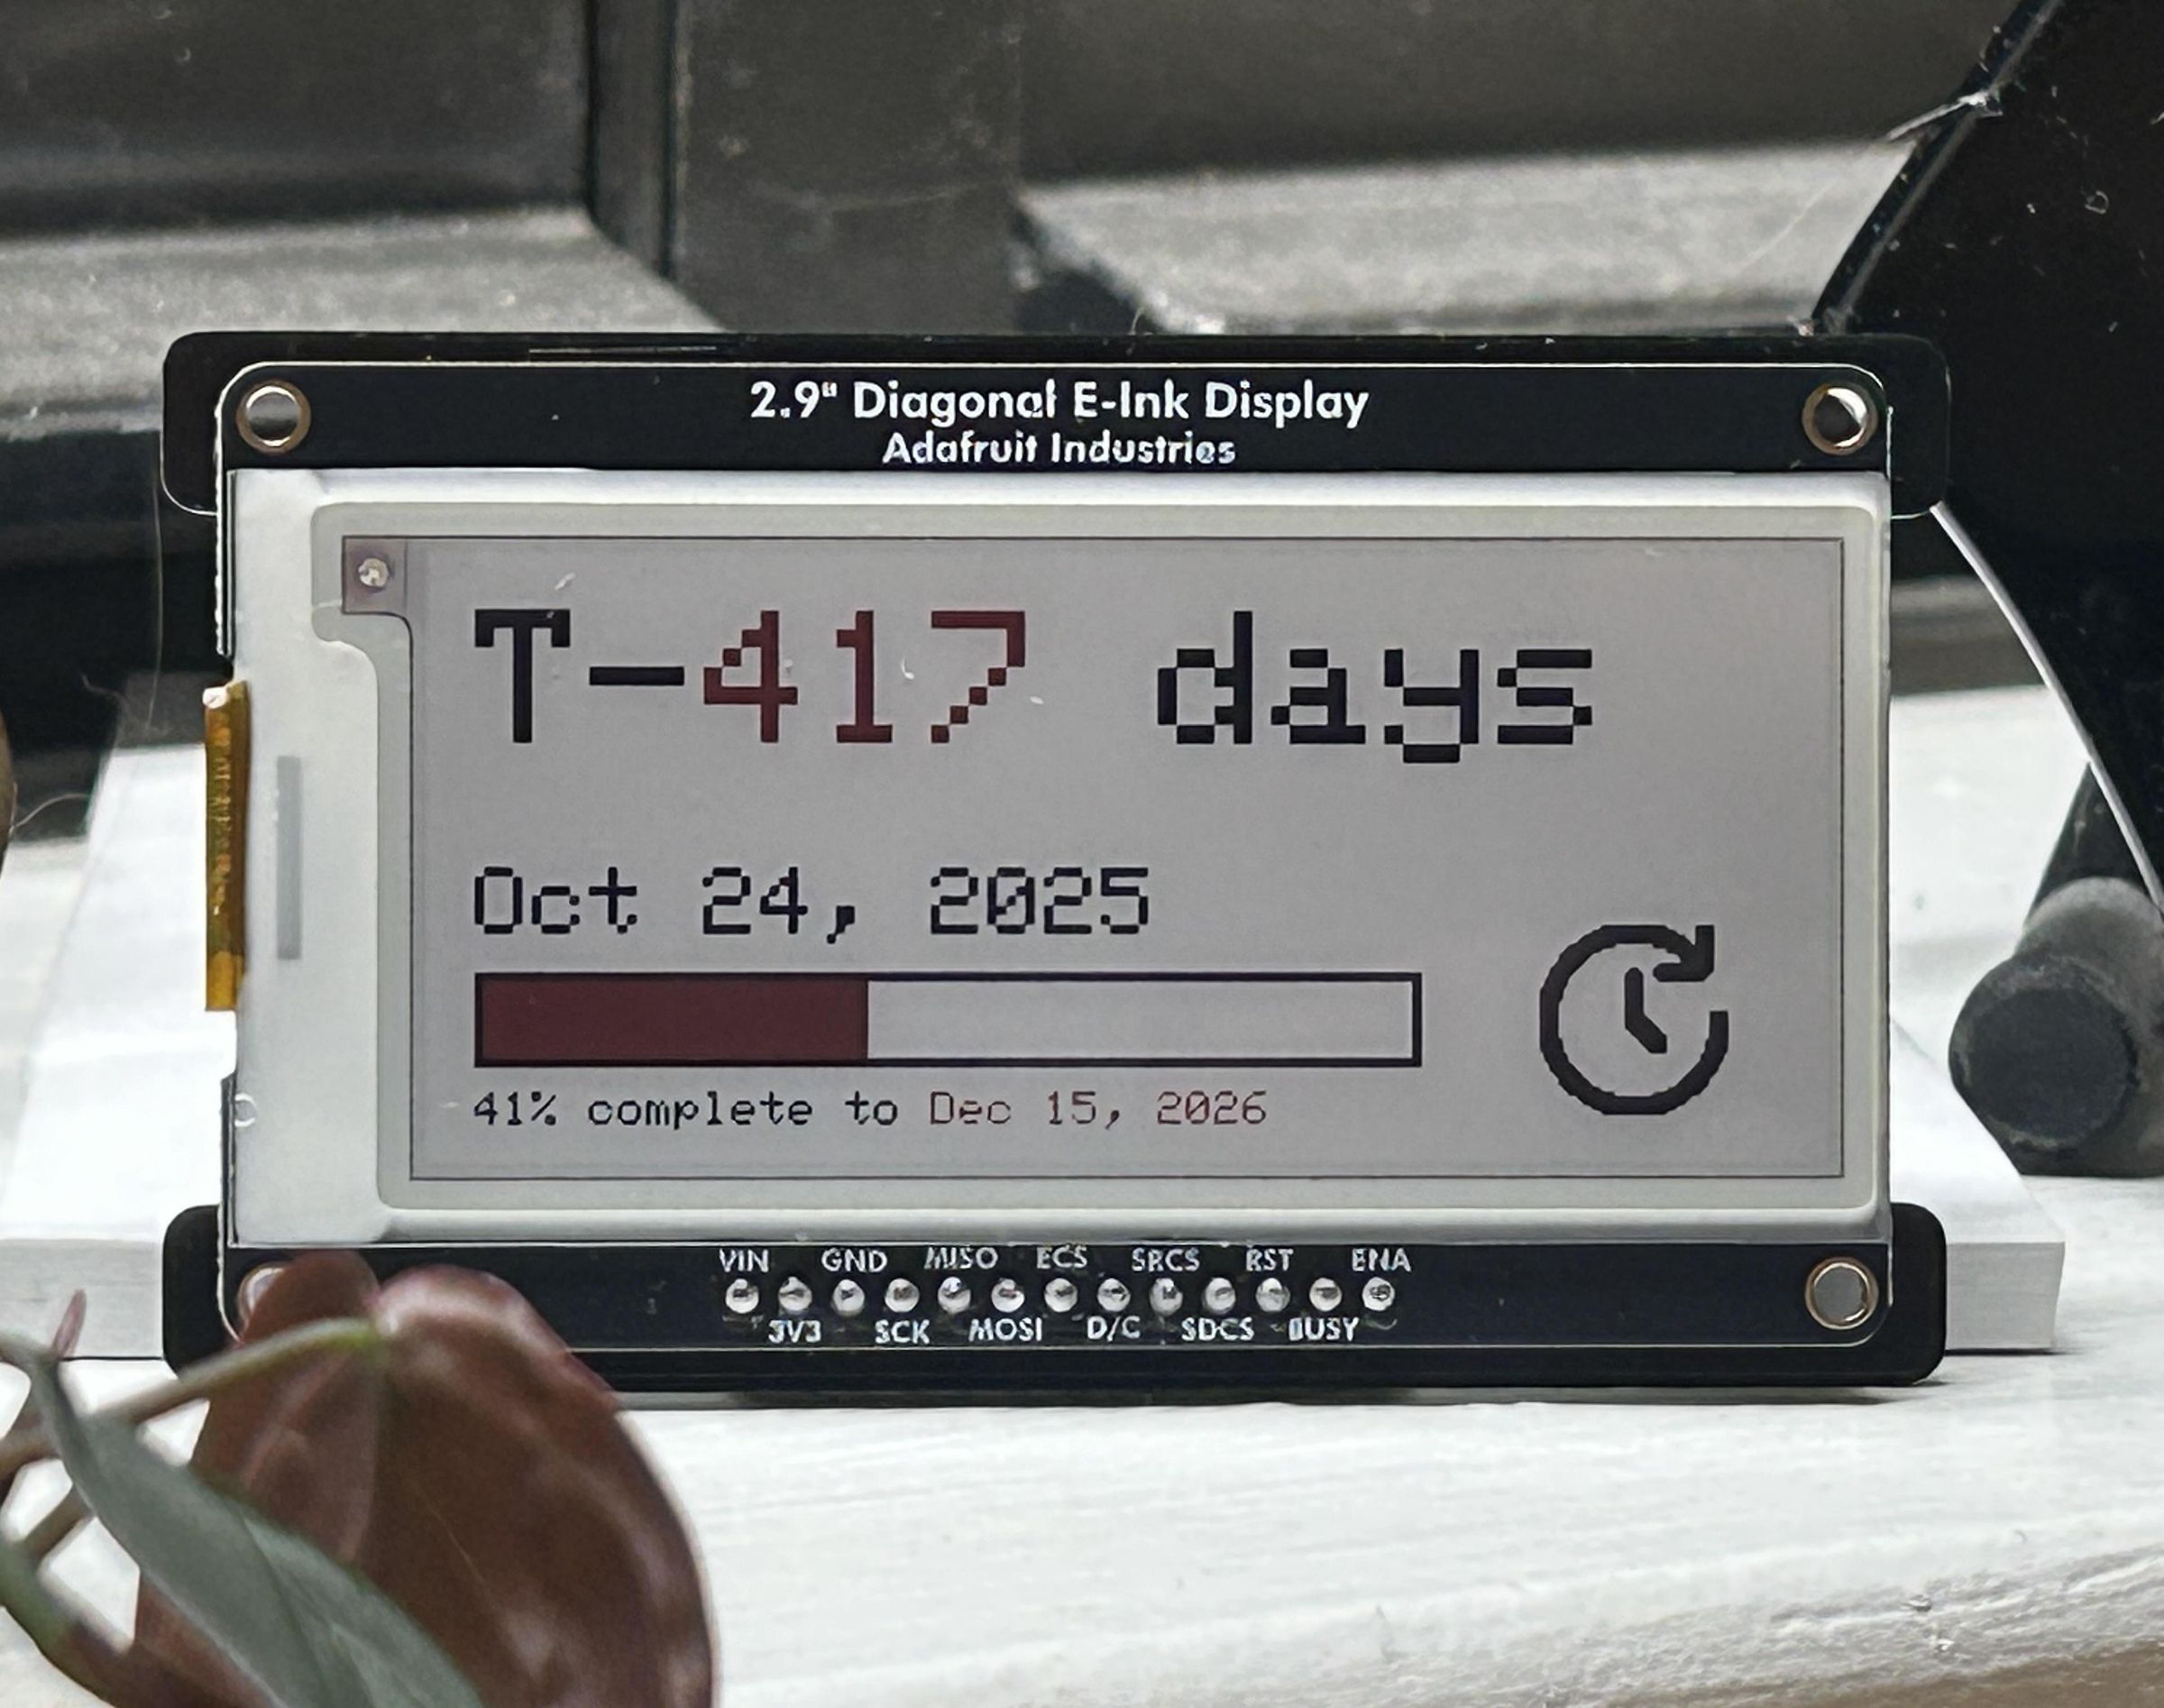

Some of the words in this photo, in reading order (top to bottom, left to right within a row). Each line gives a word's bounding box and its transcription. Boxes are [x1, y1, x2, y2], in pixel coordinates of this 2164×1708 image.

[855, 379, 1058, 427] Diagonal
[1074, 379, 1189, 419] E-Ink
[1204, 380, 1370, 428] Display
[882, 431, 1038, 464] Adafruit
[1051, 431, 1236, 464] Industries
[474, 608, 1026, 745] T-417
[1158, 610, 1593, 765] days
[474, 866, 637, 935] Oct
[701, 866, 856, 944] 24,
[931, 866, 1149, 935] 2025
[473, 1091, 556, 1125] 41%
[589, 1090, 813, 1130] complete
[844, 1091, 898, 1125] to
[930, 1091, 1011, 1125] Dec
[1049, 1091, 1120, 1129] 15,
[1157, 1091, 1267, 1125] 2026
[719, 1249, 769, 1272] VIN
[821, 1249, 888, 1272] GND
[924, 1246, 998, 1270] MISO
[1036, 1245, 1087, 1270] ECS
[1132, 1248, 1200, 1272] SRCS
[1245, 1248, 1294, 1272] RST
[1352, 1248, 1411, 1272] ENA
[768, 1320, 821, 1344] 3V3
[875, 1319, 931, 1344] SCK
[968, 1318, 1042, 1342] MOSI
[1087, 1316, 1141, 1342] D/C
[1181, 1317, 1254, 1341] SDCS
[1288, 1318, 1360, 1341] BUSY
